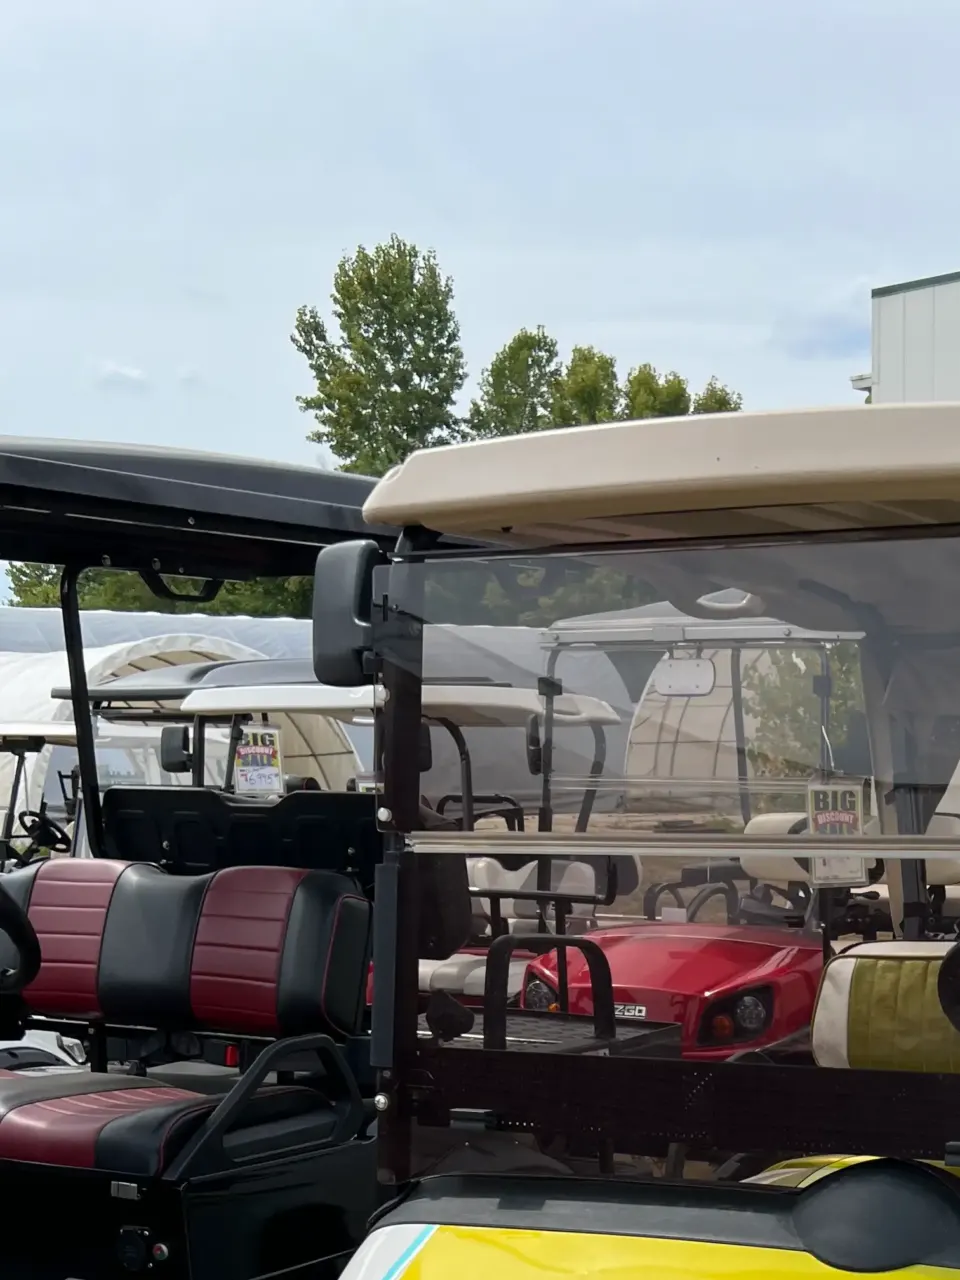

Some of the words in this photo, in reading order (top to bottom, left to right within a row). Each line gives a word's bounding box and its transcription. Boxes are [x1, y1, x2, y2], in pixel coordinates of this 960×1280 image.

[814, 790, 857, 812] BIG
[816, 811, 855, 825] DISCOUNT
[614, 1004, 647, 1017] ZGO
